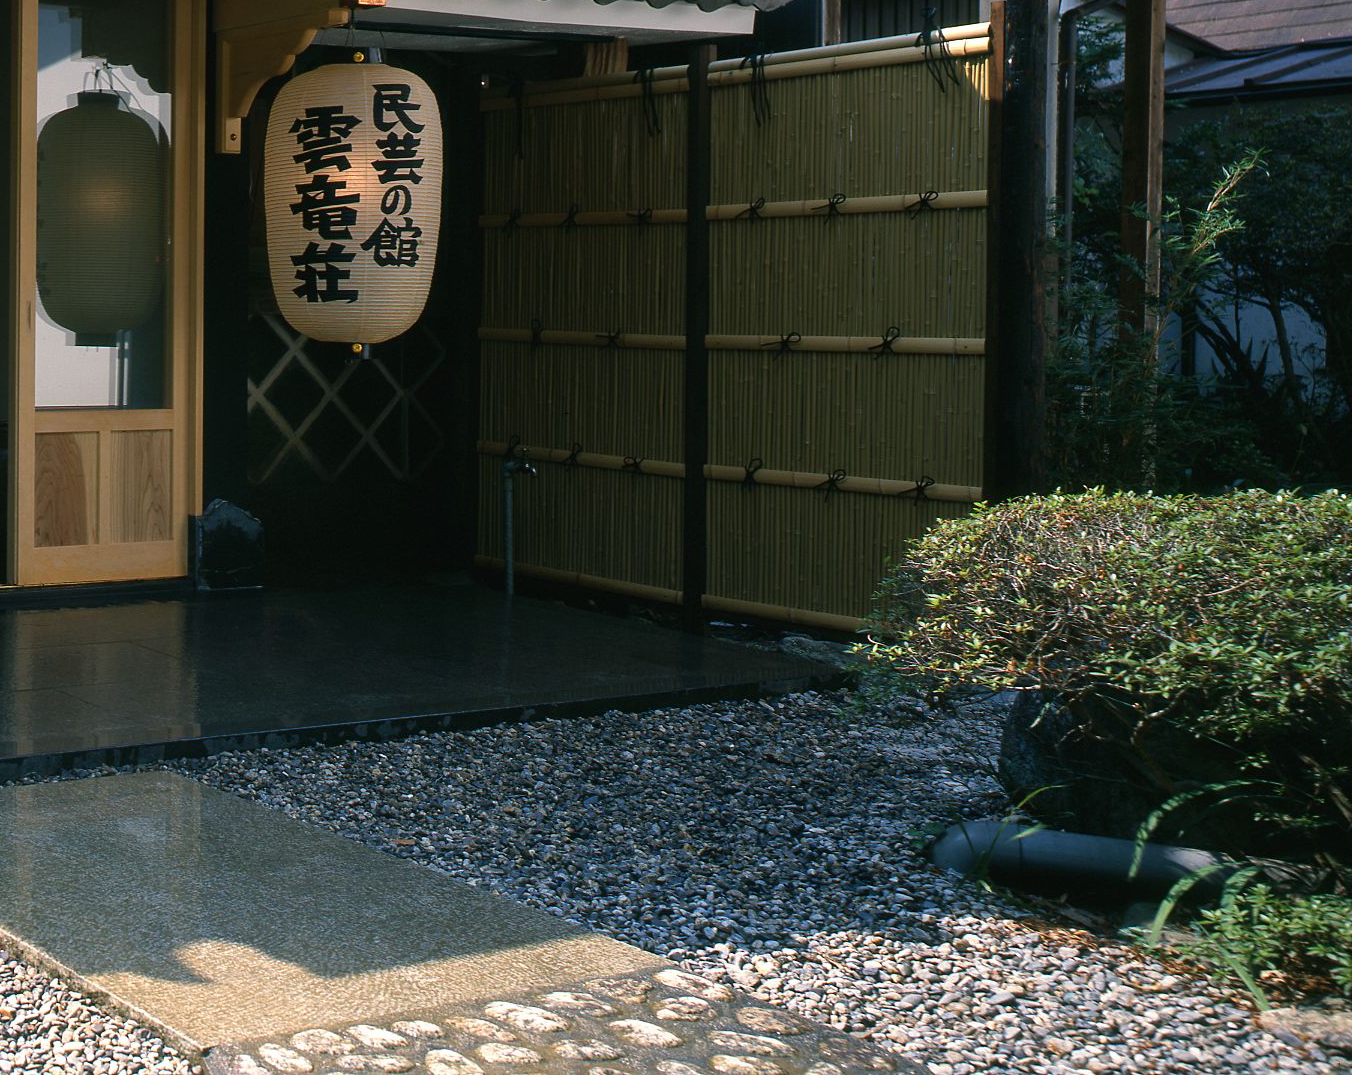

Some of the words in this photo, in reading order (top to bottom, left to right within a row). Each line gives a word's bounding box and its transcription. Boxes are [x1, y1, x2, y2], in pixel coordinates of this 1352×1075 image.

[288, 105, 363, 304] 雲竜荘
[359, 83, 426, 268] 民芸の館
